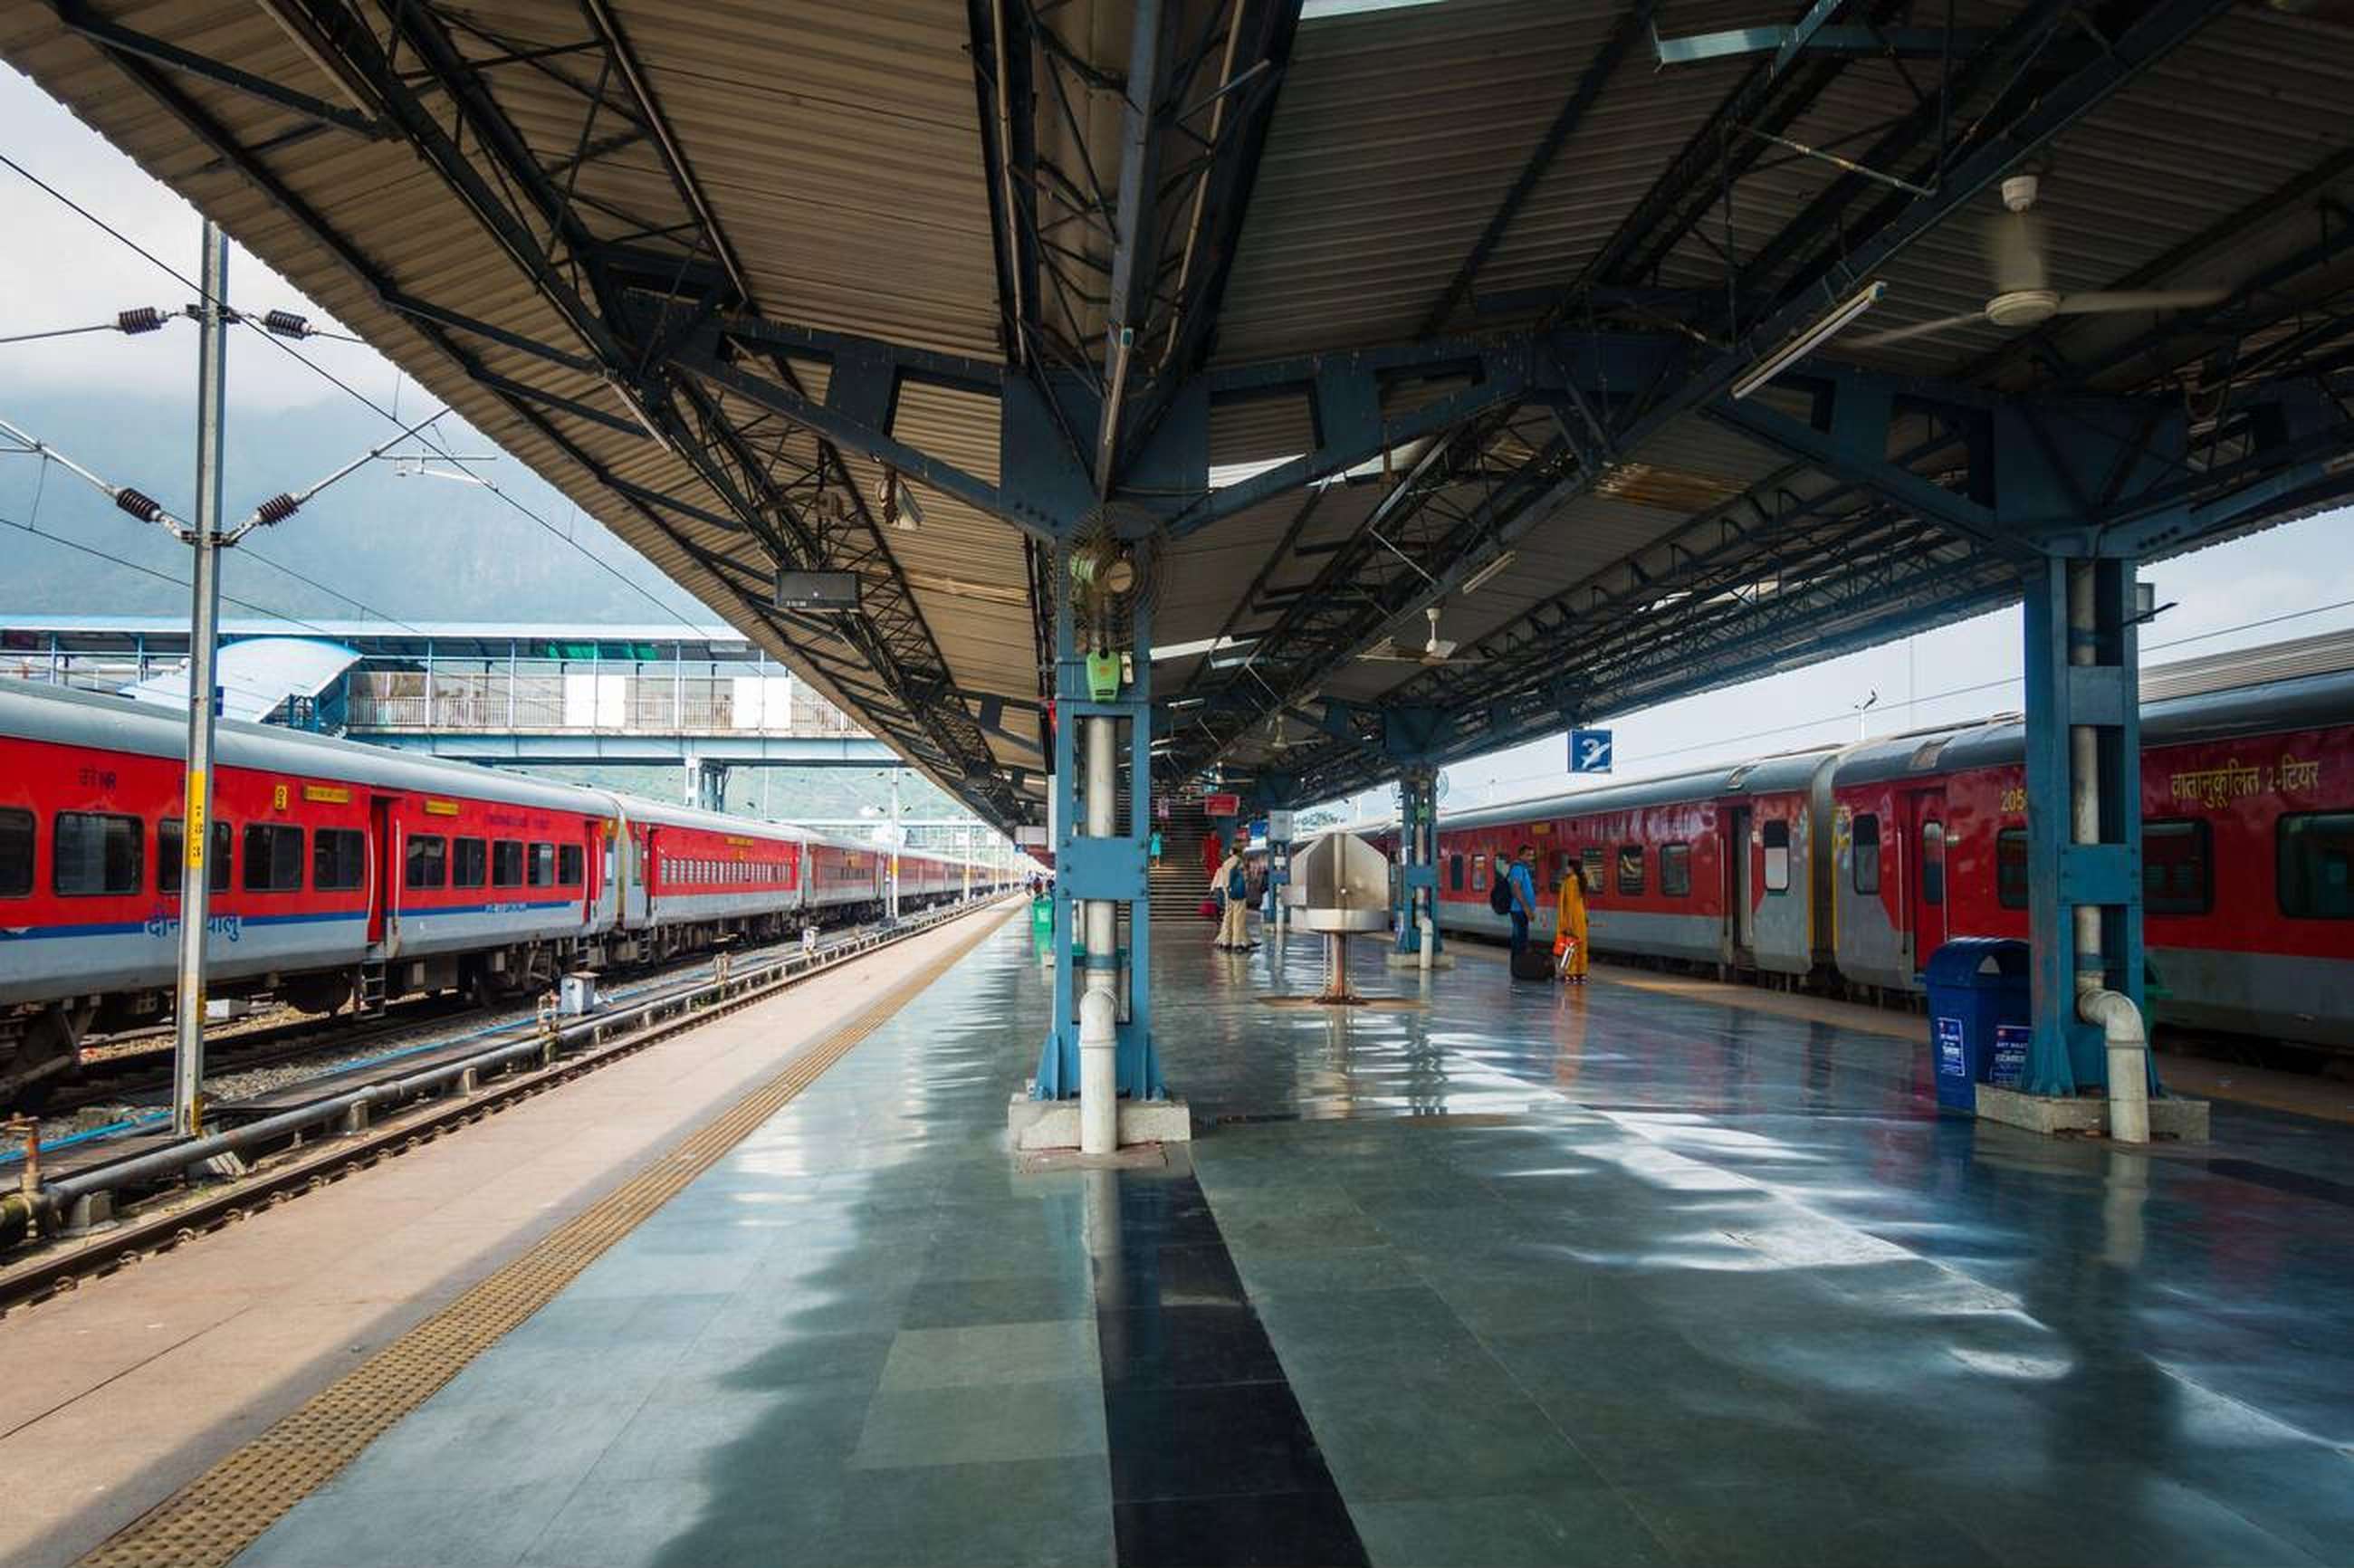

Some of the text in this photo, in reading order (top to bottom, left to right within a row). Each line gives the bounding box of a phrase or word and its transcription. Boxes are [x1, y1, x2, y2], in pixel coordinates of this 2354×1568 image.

[1581, 738, 1611, 771] 2
[2171, 758, 2260, 808] वातानुकूलित
[2000, 789, 2029, 812] 205
